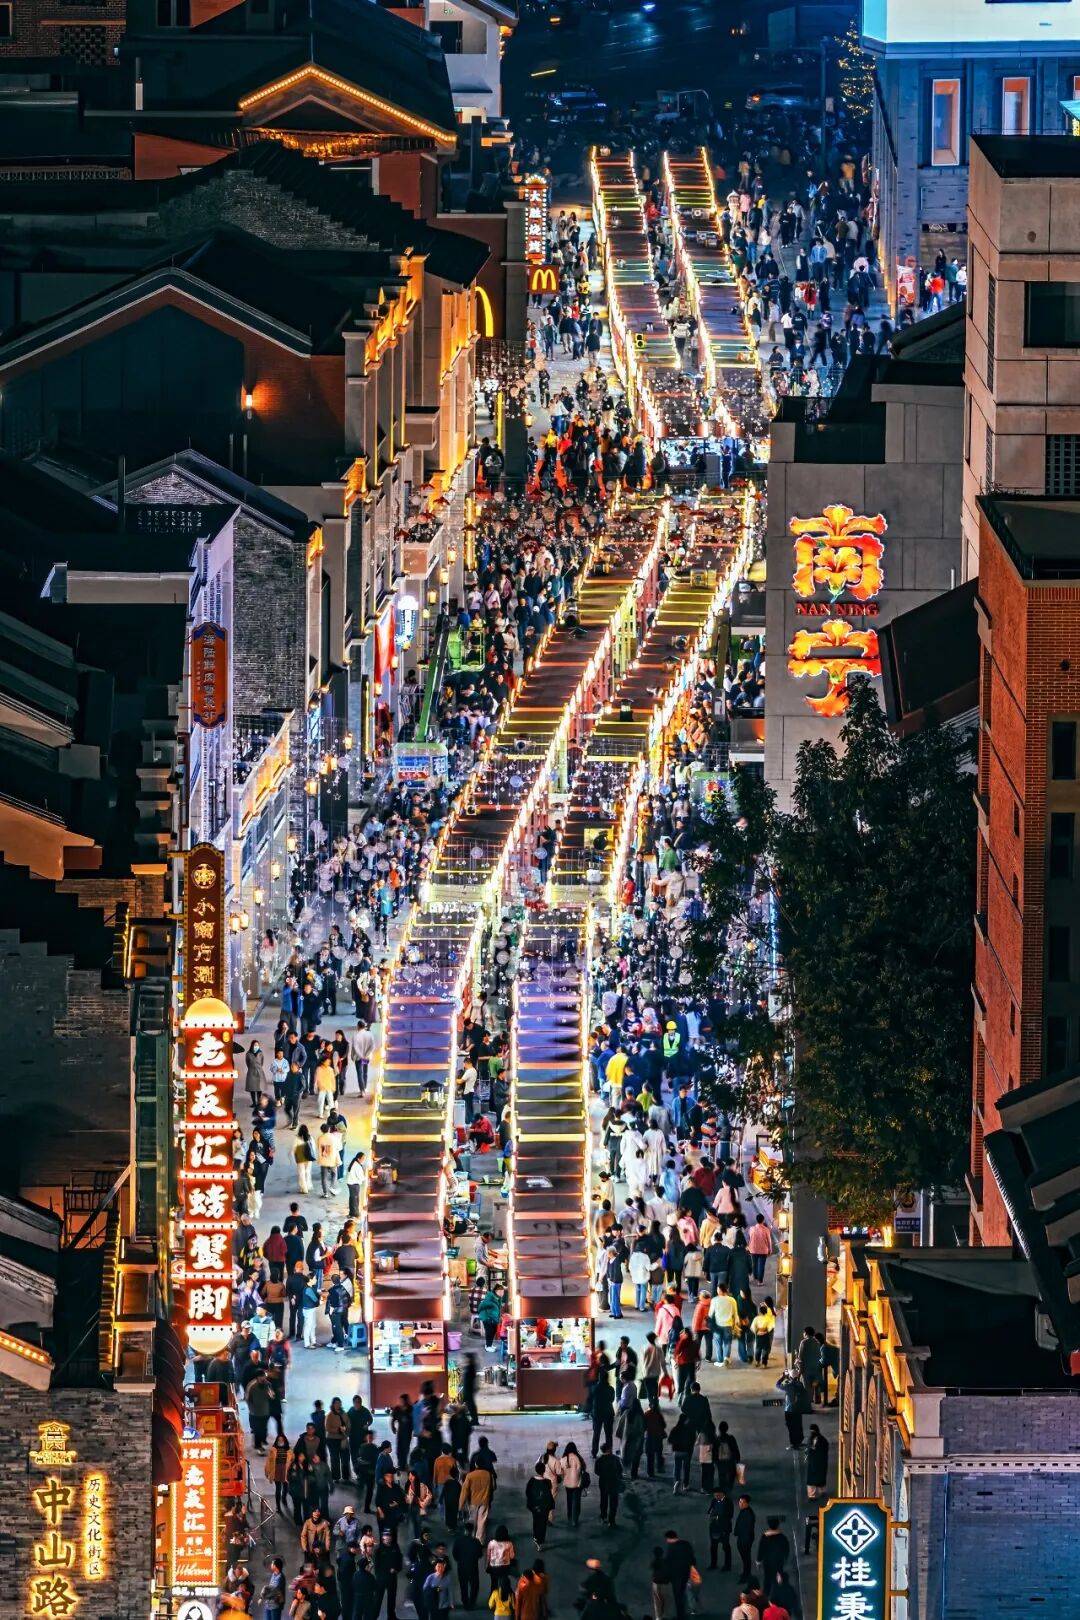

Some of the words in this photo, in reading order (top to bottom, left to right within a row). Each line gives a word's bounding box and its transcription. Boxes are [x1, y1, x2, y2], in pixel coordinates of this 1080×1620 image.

[796, 602, 832, 617] NAN
[834, 602, 879, 617] NING
[188, 1031, 228, 1320] 老友汇螃蟹脚
[32, 1479, 77, 1616] 中山路
[87, 1478, 102, 1576] 历史文化街区
[183, 1464, 206, 1533] 老友汇
